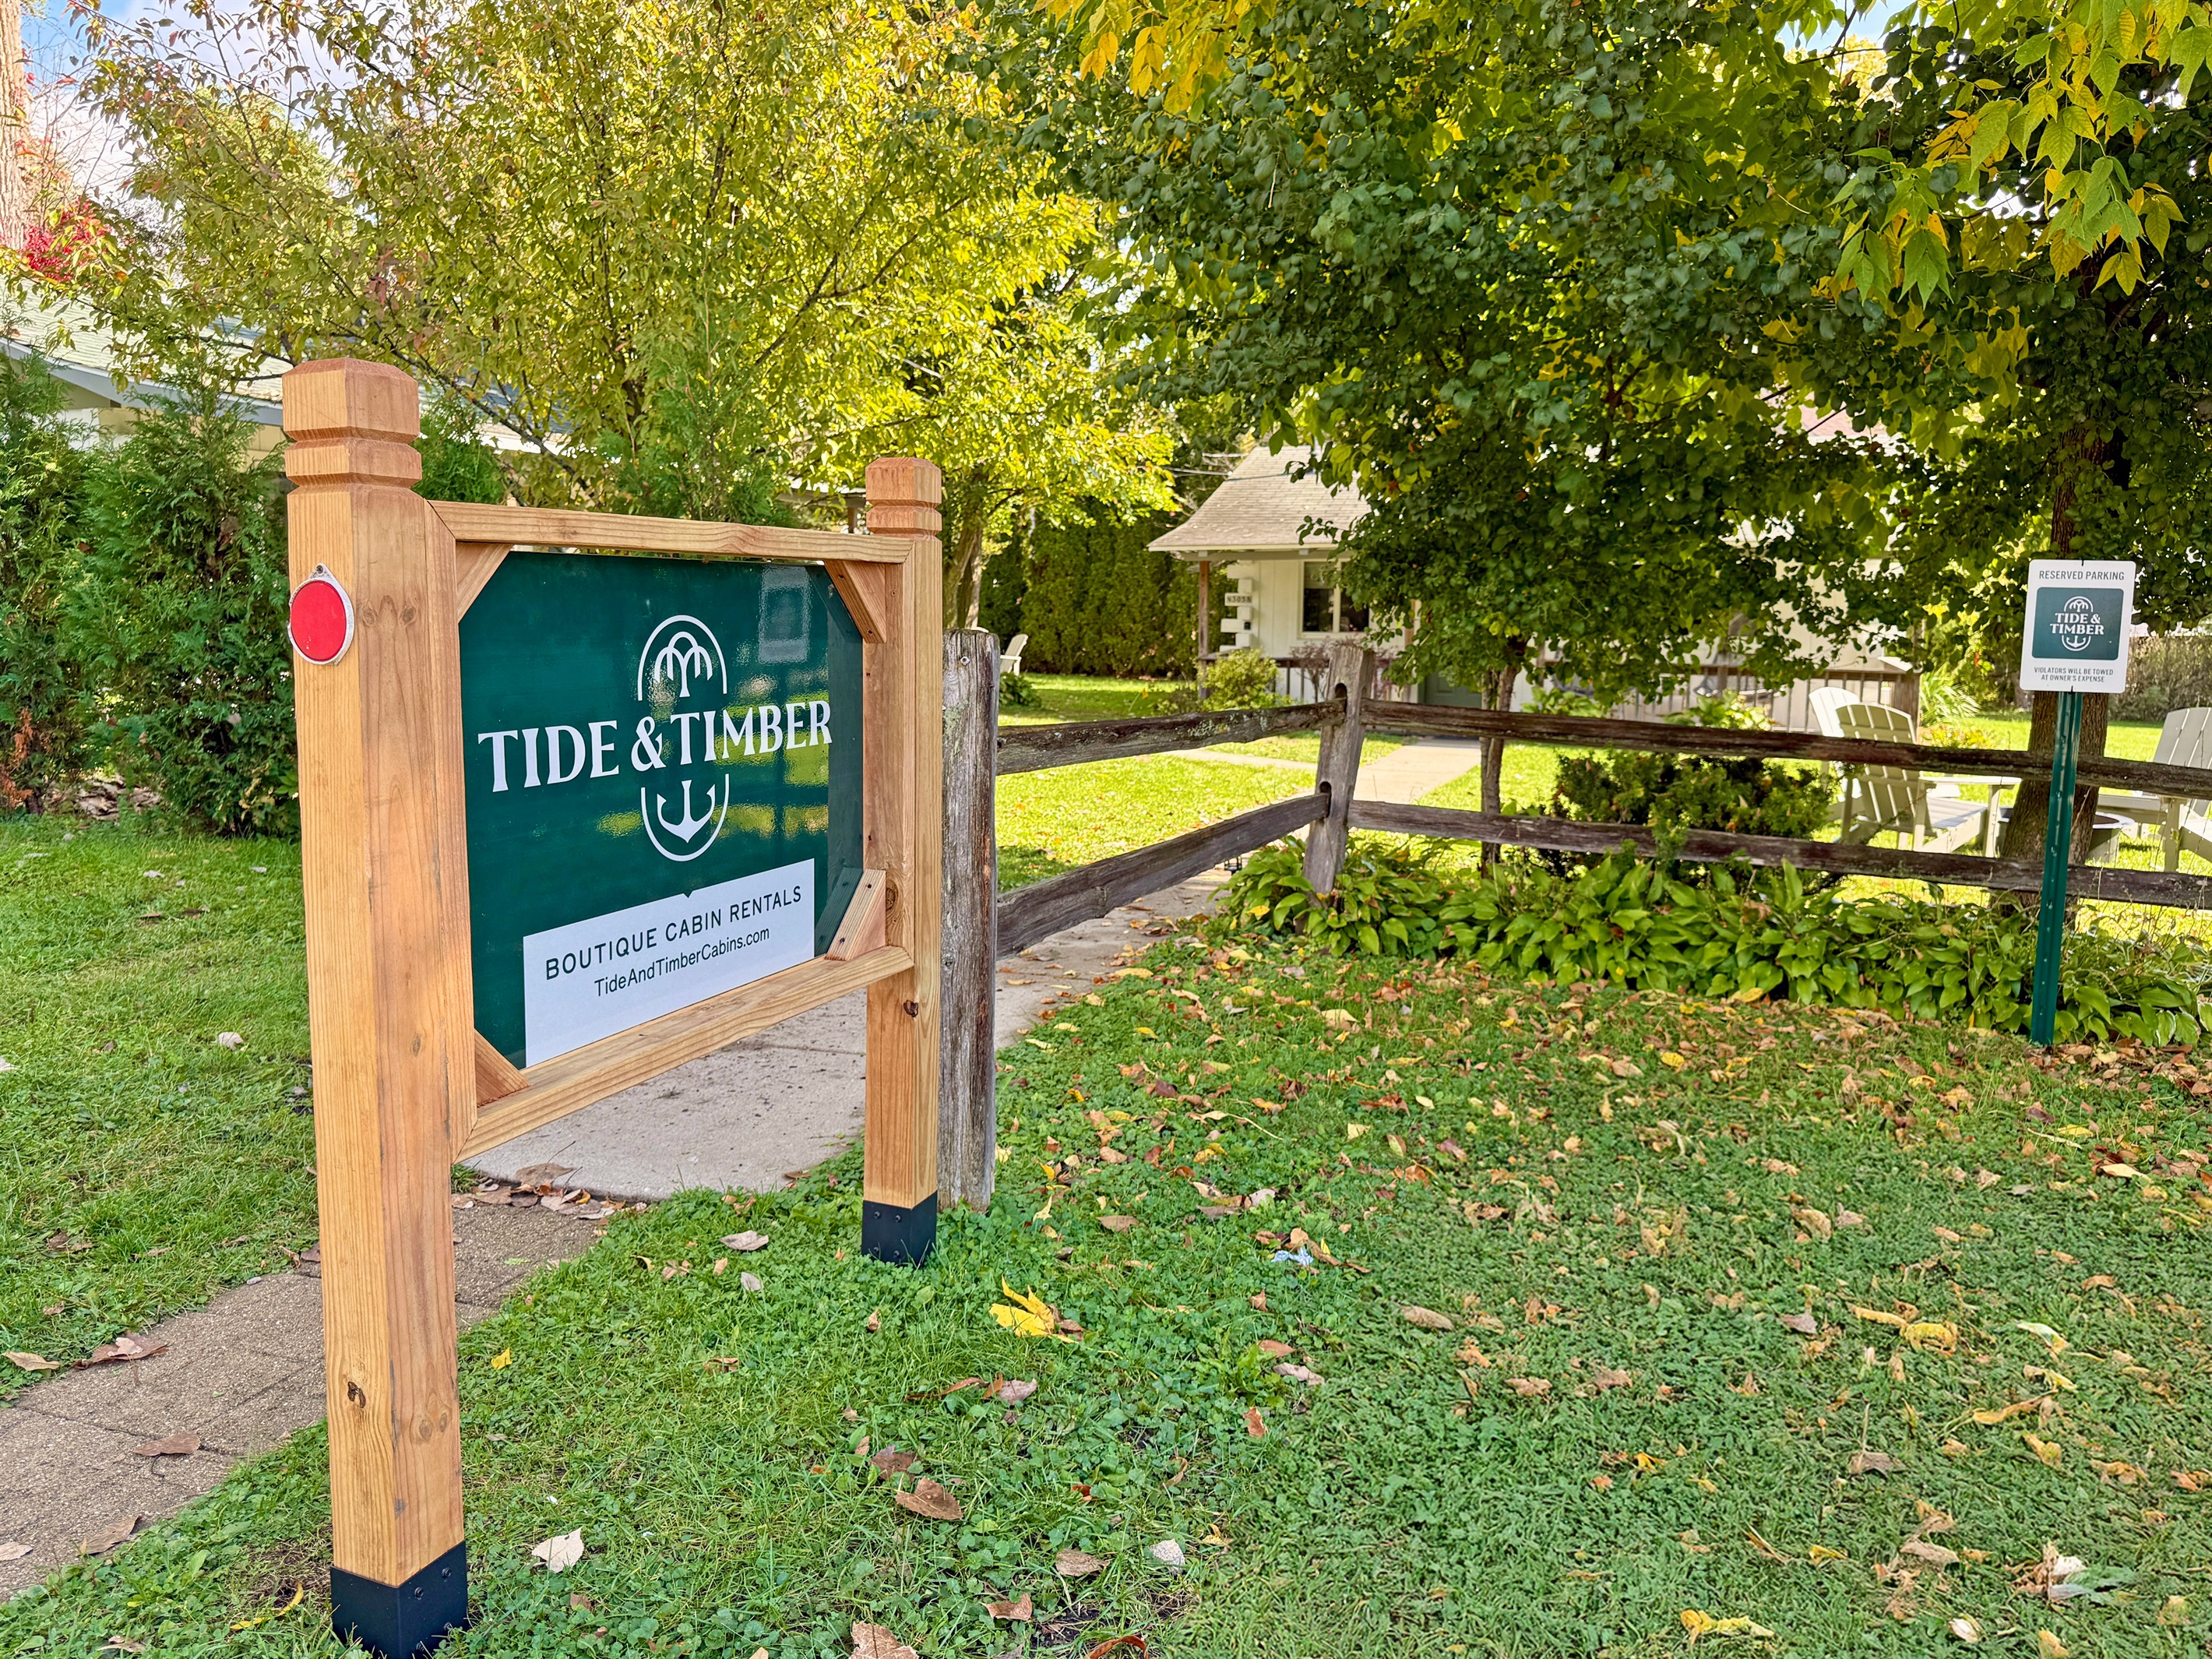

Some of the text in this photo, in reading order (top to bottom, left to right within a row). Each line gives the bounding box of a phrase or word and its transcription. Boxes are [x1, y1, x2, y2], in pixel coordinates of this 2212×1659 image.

[2038, 570, 2125, 581] RESERVED PARKING
[2049, 623, 2105, 635] TIMBER
[2054, 612, 2101, 625] TIDE &
[477, 700, 833, 793] TIDE & TIMBER
[546, 886, 801, 981] BOUTIQUE CABIN RENTALS
[594, 928, 770, 997] TideAndTimberCabins.com
